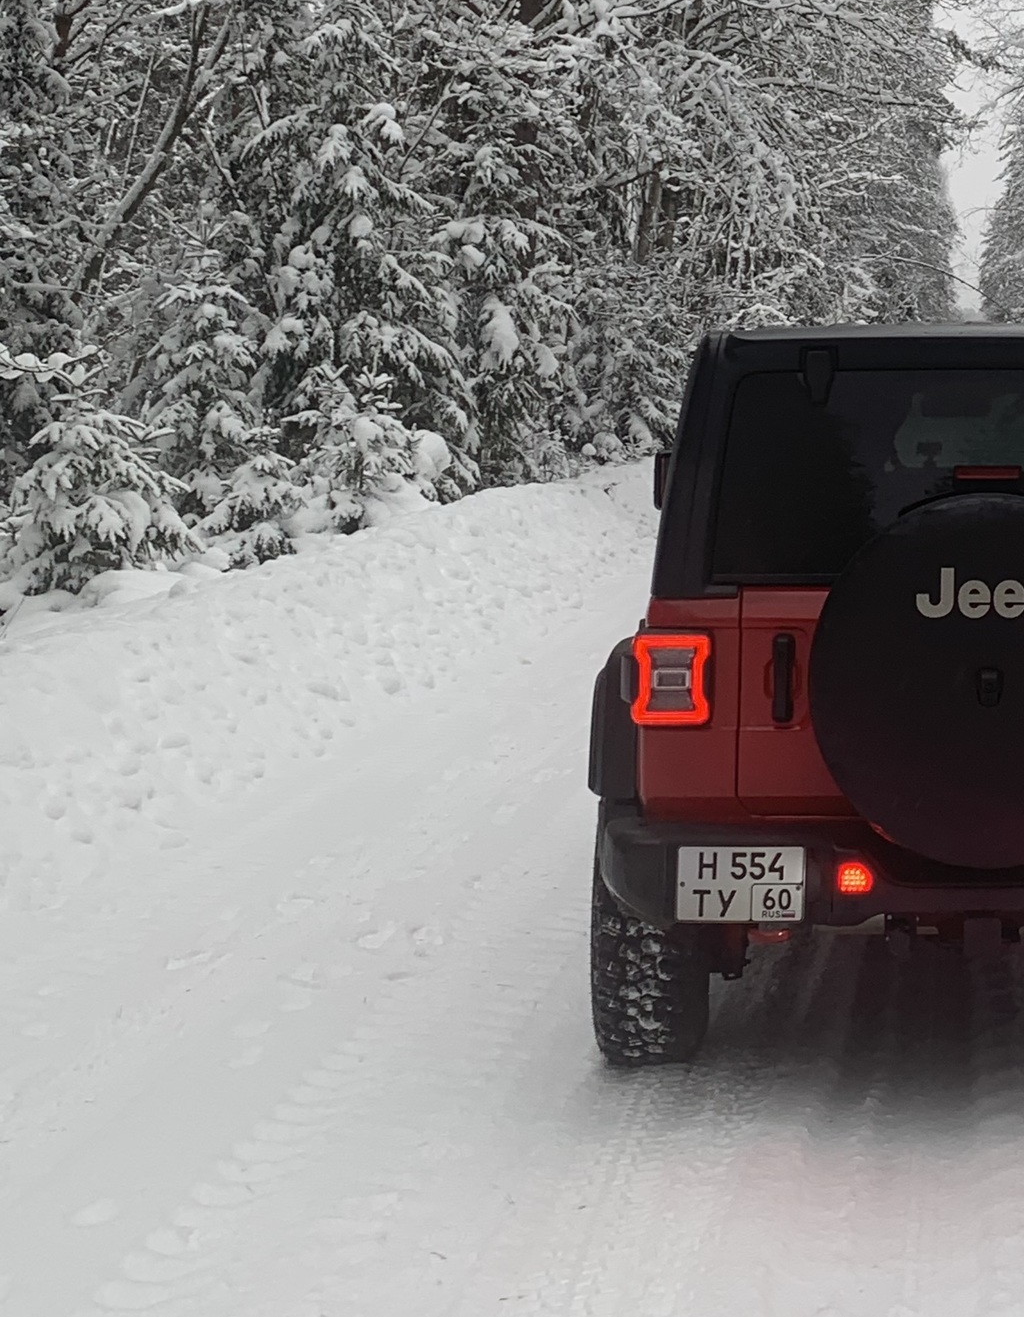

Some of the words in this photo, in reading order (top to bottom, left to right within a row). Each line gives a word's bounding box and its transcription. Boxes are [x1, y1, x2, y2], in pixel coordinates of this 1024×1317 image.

[730, 851, 785, 881] 554
[763, 888, 792, 910] 60
[761, 910, 781, 918] RUS
